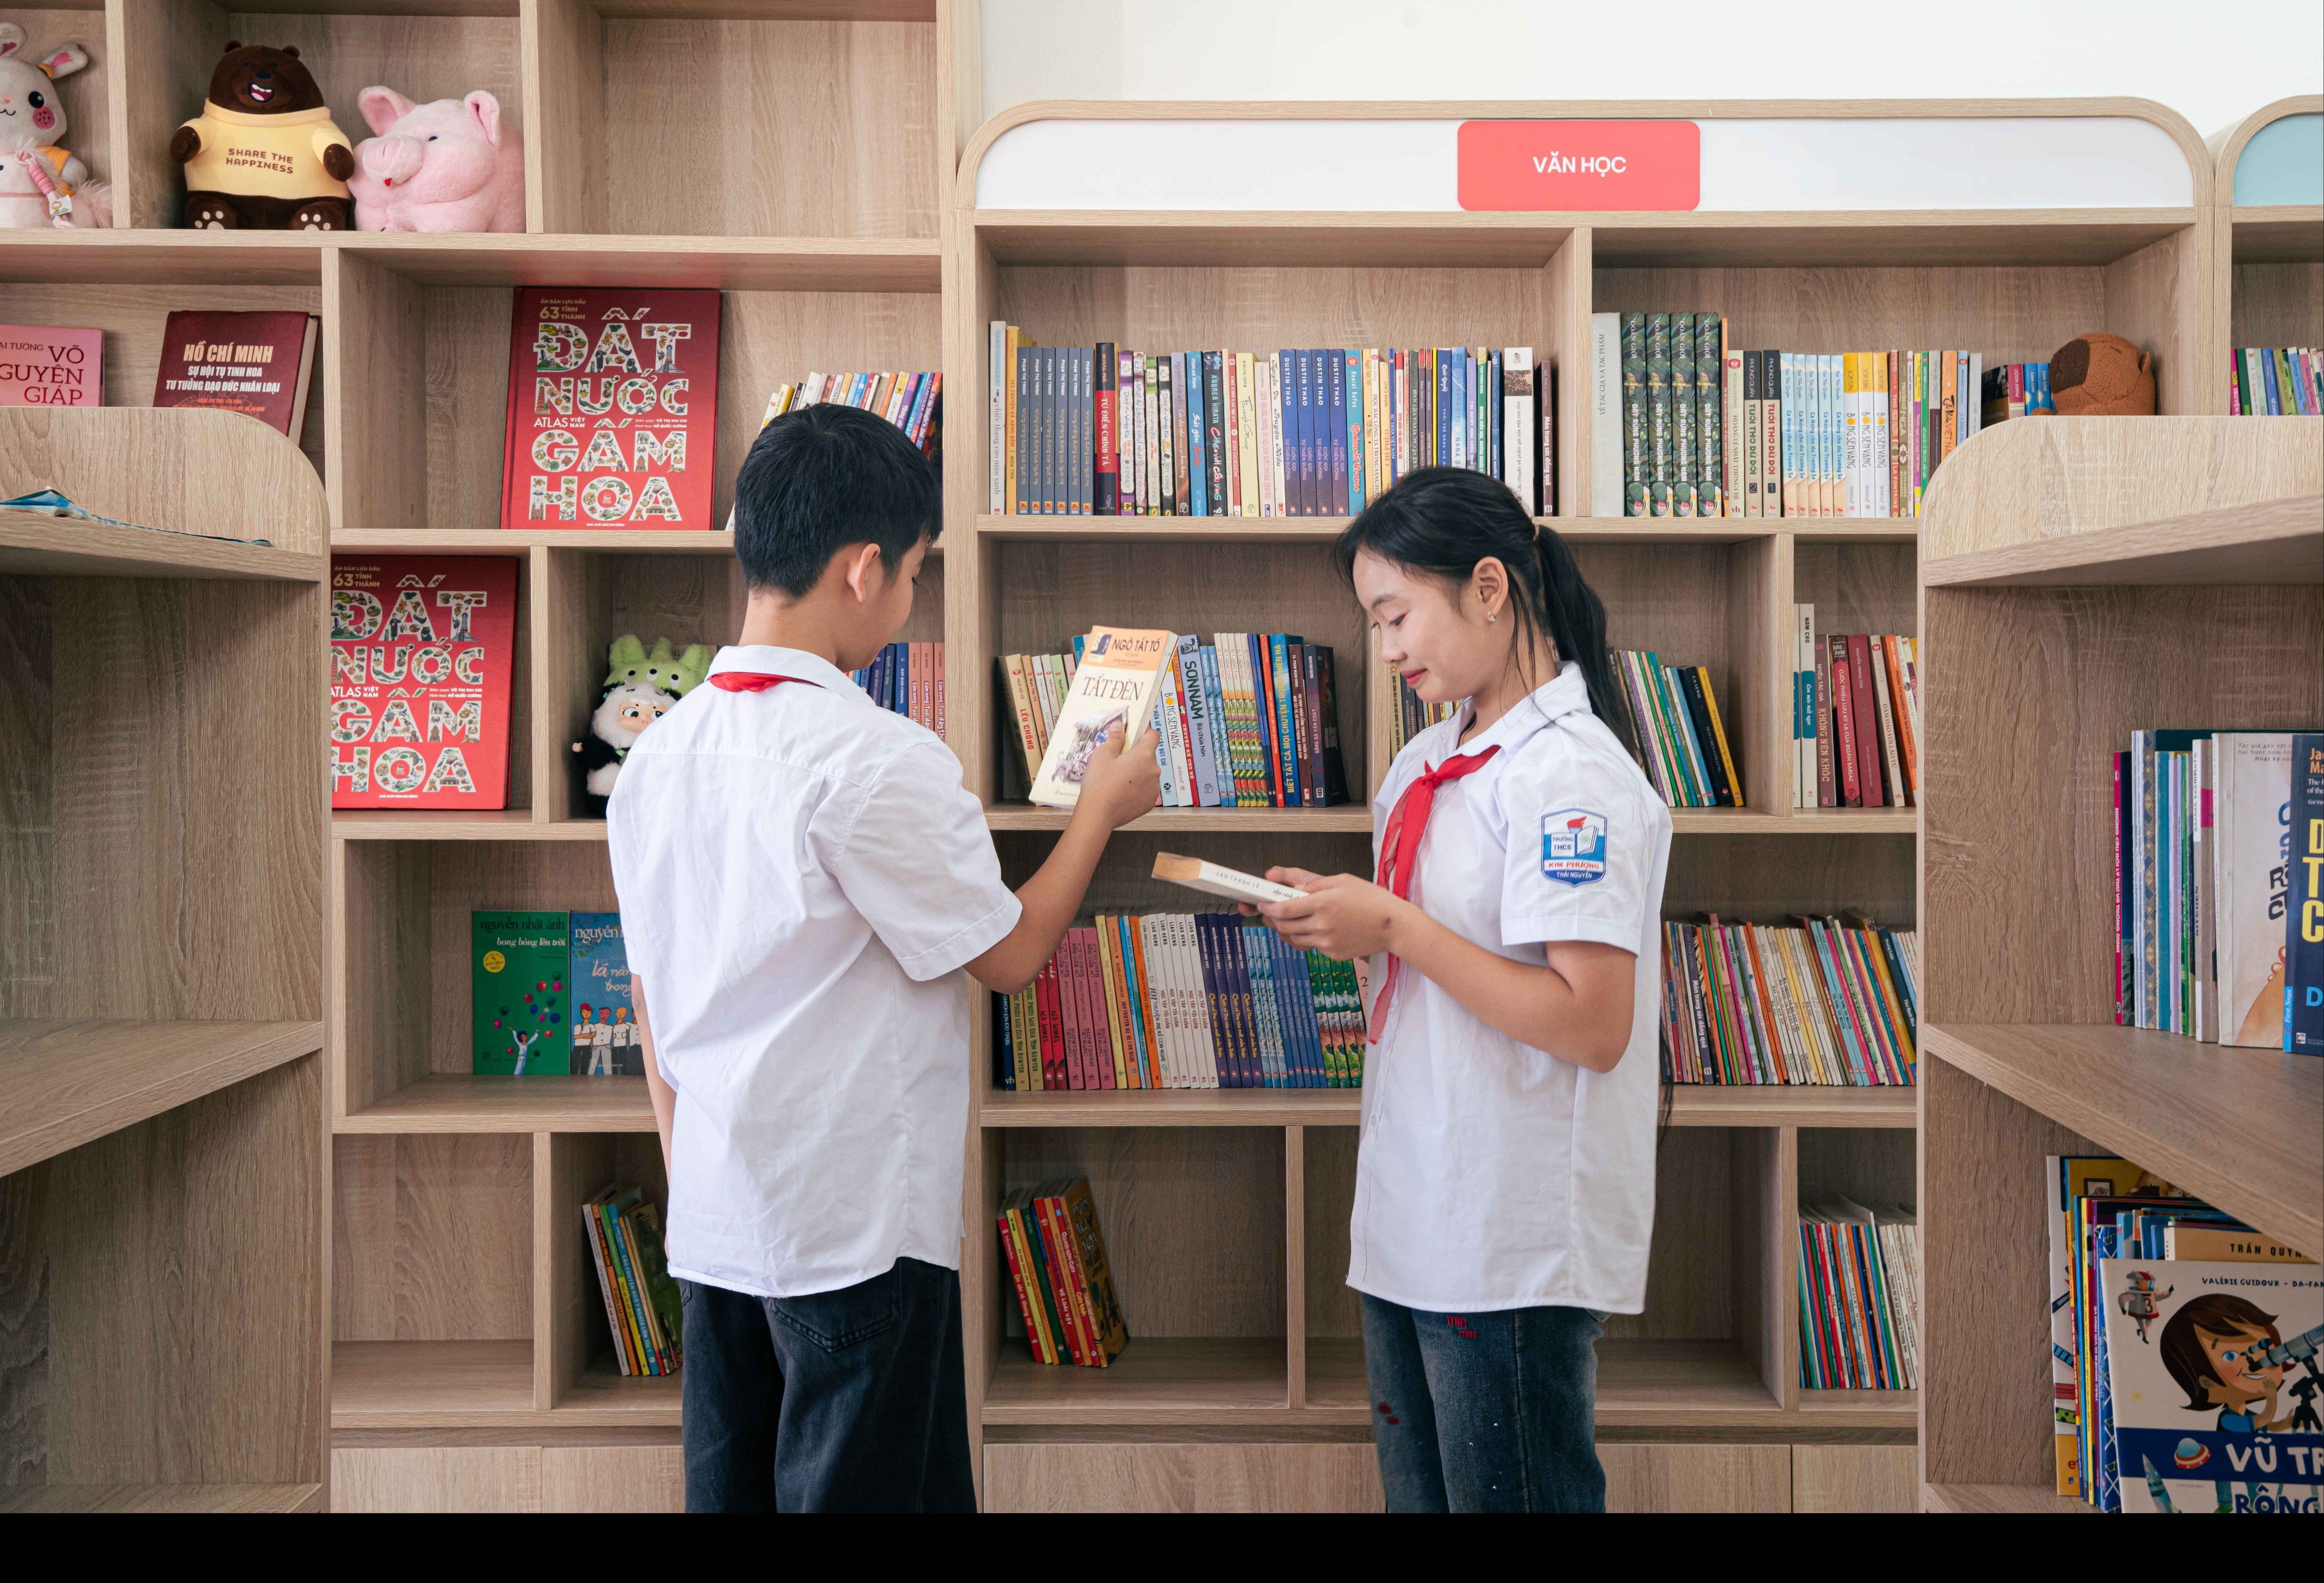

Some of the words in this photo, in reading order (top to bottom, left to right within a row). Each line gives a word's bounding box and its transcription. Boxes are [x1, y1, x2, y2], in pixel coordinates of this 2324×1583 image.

[228, 149, 267, 158] SHARE
[271, 153, 293, 164] THE
[1533, 151, 1575, 173] VĂN
[1581, 156, 1626, 177] HỌC
[226, 158, 293, 174] HAPPINESS
[539, 306, 559, 319] 63
[10, 342, 43, 351] TƯỚNG
[533, 308, 691, 373] ĐẤT
[48, 345, 84, 364] VÕ
[183, 341, 206, 361] HỒ
[207, 342, 234, 362] CHÍ
[234, 345, 273, 363] MINH
[188, 365, 200, 378] SỰ
[200, 365, 214, 378] HỘI
[216, 367, 226, 378] TỤ
[227, 367, 245, 377] TINH
[246, 367, 262, 377] HOA
[166, 380, 177, 389] TƯ
[178, 378, 203, 391] TƯỞNG
[205, 381, 220, 393] ĐẠO
[222, 381, 239, 391] ĐỨC
[239, 381, 262, 392] NHÂN
[262, 382, 280, 394] LOẠI
[534, 368, 690, 415] NƯỚC
[24, 385, 82, 405] GIÁP
[1102, 397, 1110, 407] TỪ
[1274, 391, 1279, 400] Du
[534, 417, 568, 428] ATLAS
[532, 418, 687, 473] GẤM
[1102, 431, 1110, 454] CHÍNH
[1102, 455, 1110, 465] TẢ
[1893, 465, 1897, 475] LA
[529, 476, 682, 521] HOA
[331, 575, 487, 642] ĐẤT
[1112, 636, 1133, 651] NGÔ
[1134, 636, 1149, 652] TẤT
[1149, 636, 1162, 652] TỐ
[1274, 645, 1283, 654] HẠ
[331, 637, 484, 684] NƯỚC
[1275, 657, 1283, 676] THIÊN
[1082, 673, 1111, 697] TẮT
[1111, 679, 1144, 701] ĐÈN
[331, 687, 482, 744] GẤM
[1020, 709, 1030, 722] LỀU
[1279, 705, 1289, 733] CHUYỆN
[1819, 708, 1827, 736] KHÔNG
[1023, 724, 1034, 750] CHÕNG
[1282, 735, 1292, 749] MỌI
[1820, 739, 1829, 755] NÊN
[331, 746, 476, 792] HOA
[1282, 763, 1292, 776] TẤT
[1821, 758, 1830, 782] KHÓC
[1285, 779, 1294, 793] BIẾT
[1567, 862, 1599, 871] PHƯỢNG
[481, 916, 518, 932] nguyễn
[522, 918, 543, 931] nhật
[546, 918, 564, 929] ánh
[575, 925, 618, 943] nguyễn
[497, 937, 516, 948] bong
[518, 937, 537, 948] bóng
[552, 937, 566, 946] trời
[592, 959, 609, 977] lá
[2271, 1247, 2307, 1257] QUYN
[2202, 1276, 2238, 1285] VALÉRIE
[2144, 1297, 2153, 1313] 3
[2225, 1437, 2277, 1472] VŨ
